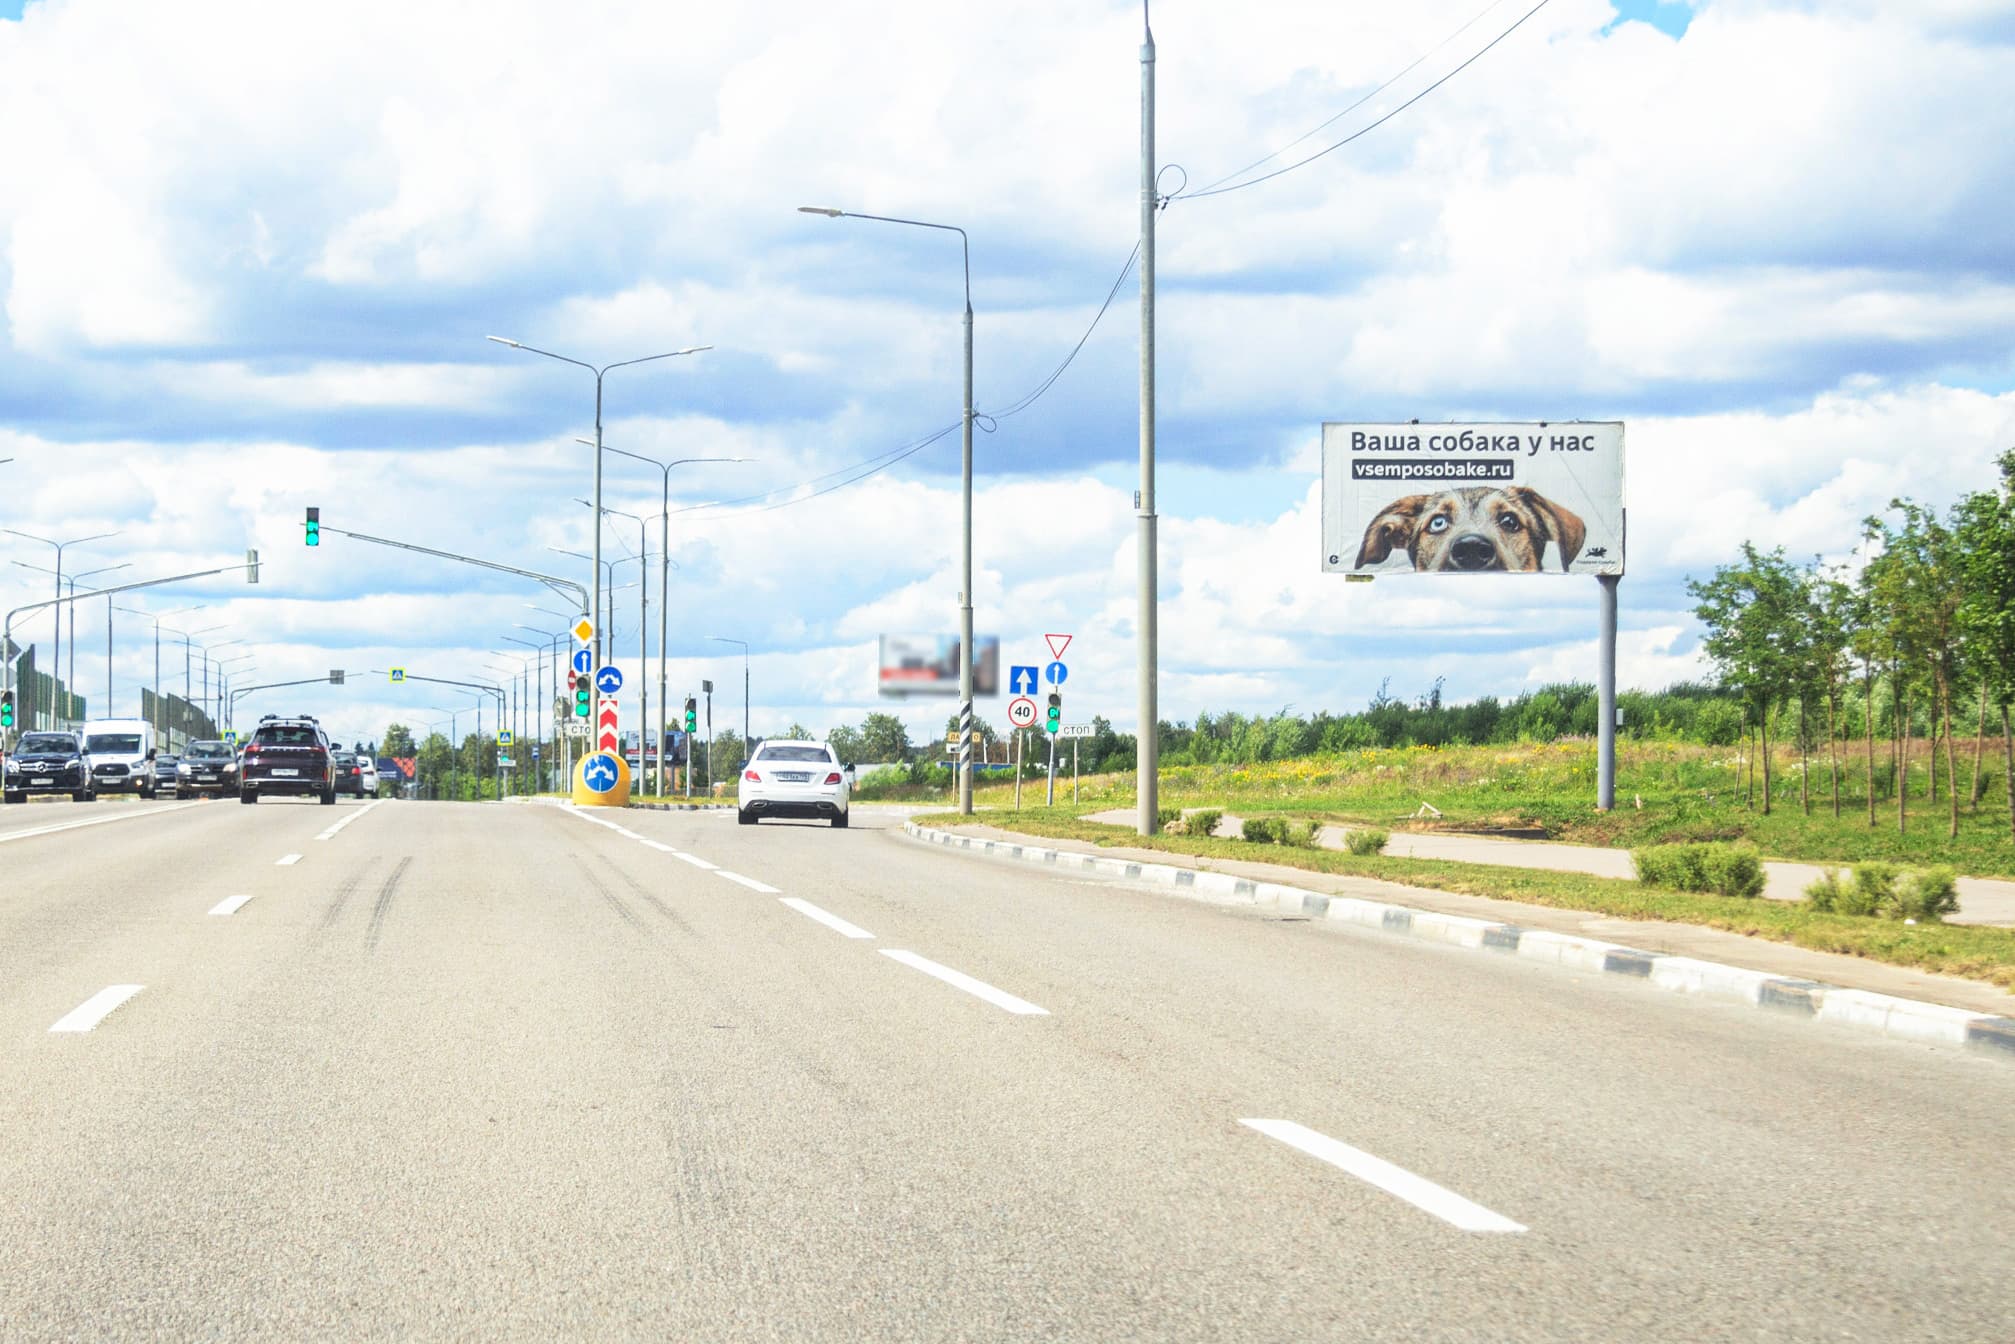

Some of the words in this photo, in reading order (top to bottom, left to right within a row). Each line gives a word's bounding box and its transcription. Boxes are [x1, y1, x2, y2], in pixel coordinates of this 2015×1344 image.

[1351, 431, 1420, 451] Ваша
[1428, 430, 1520, 452] собака
[1527, 435, 1543, 457] у
[1550, 435, 1595, 452] нас
[1355, 462, 1511, 479] vsemposobake.ru
[1014, 706, 1030, 717] 40
[571, 725, 591, 735] СТО
[1063, 726, 1090, 735] СТОП
